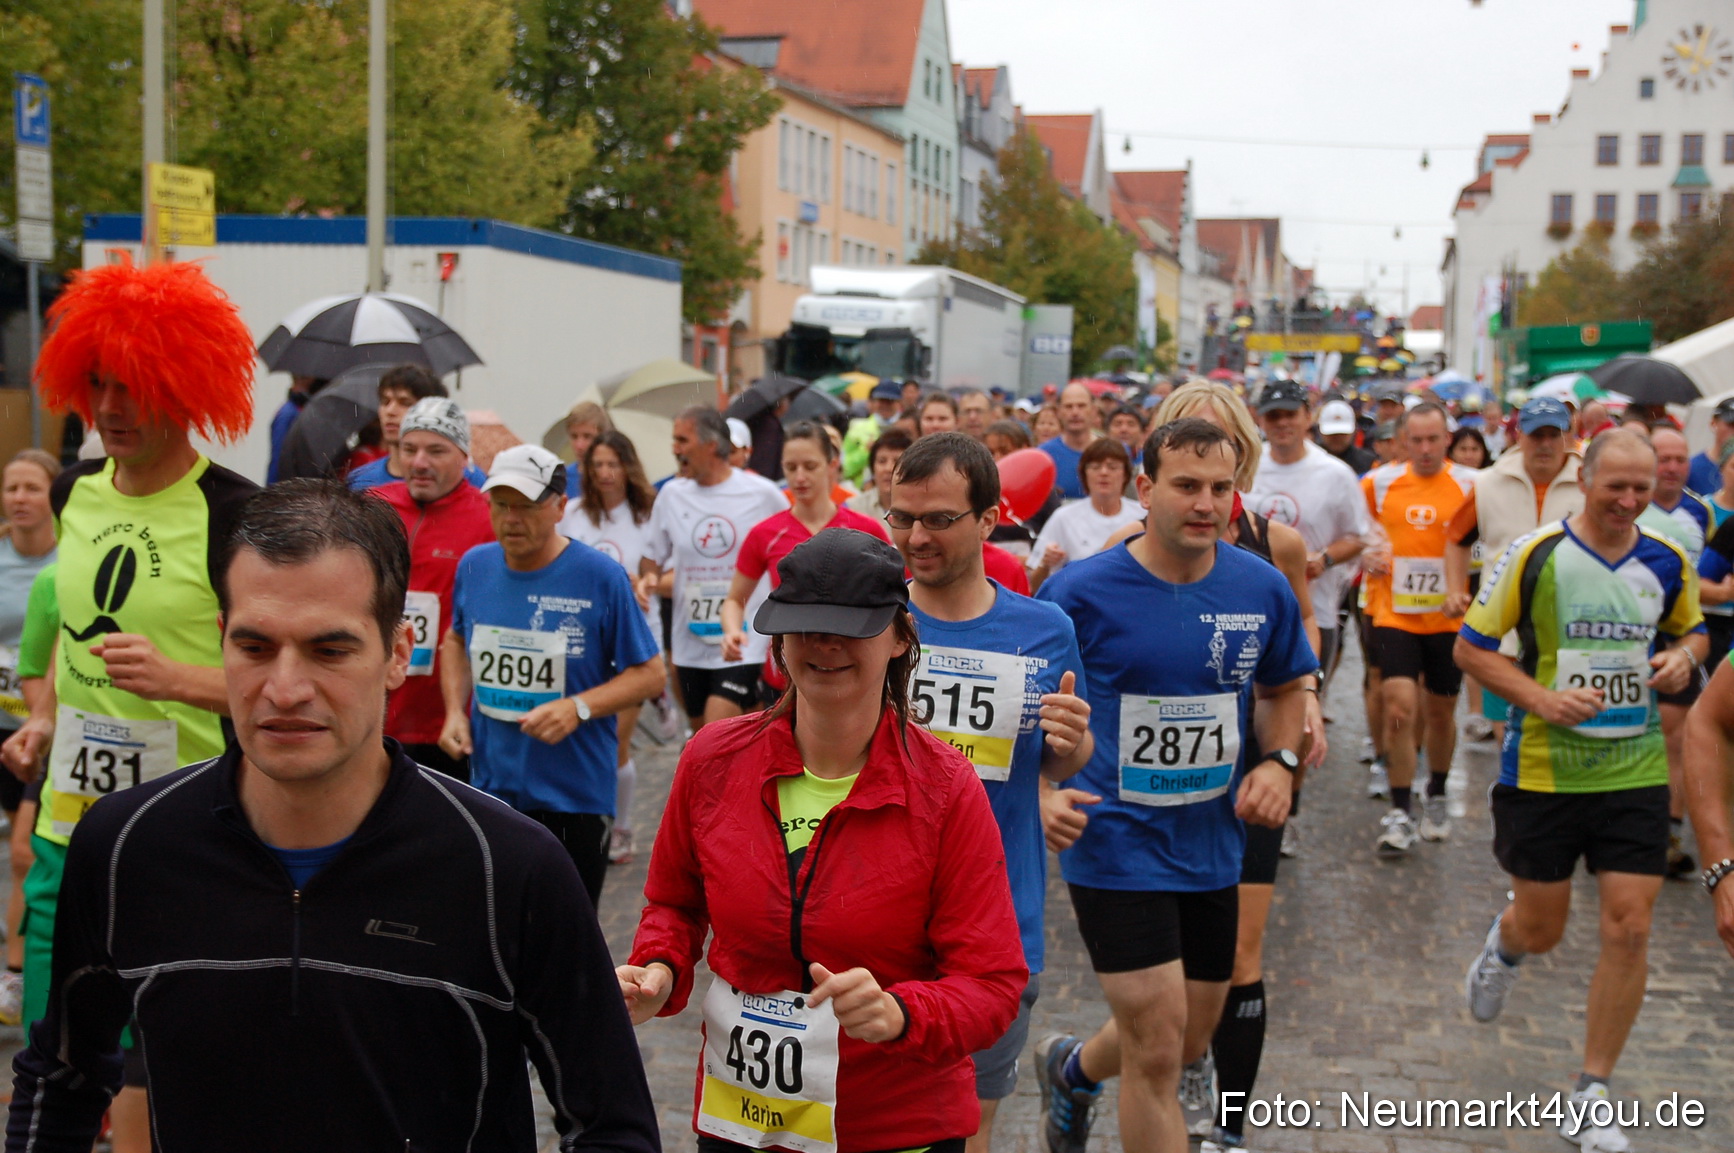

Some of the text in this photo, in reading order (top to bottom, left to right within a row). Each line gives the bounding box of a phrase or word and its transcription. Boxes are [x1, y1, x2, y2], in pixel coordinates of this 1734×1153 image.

[139, 527, 161, 578] bean
[1404, 573, 1440, 593] 472
[1199, 614, 1215, 623] 12.
[1566, 620, 1656, 642] BOCK
[479, 651, 554, 689] 2694
[928, 655, 983, 672] BOCK
[491, 692, 536, 710] Ludwig
[911, 679, 995, 732] 515
[1159, 703, 1207, 715] BOCK
[1132, 724, 1225, 766] 2871
[70, 746, 142, 794] 431
[1149, 773, 1208, 791] Christof
[742, 994, 796, 1018] BOCK
[726, 1024, 804, 1095] 430
[740, 1096, 784, 1127] Karin
